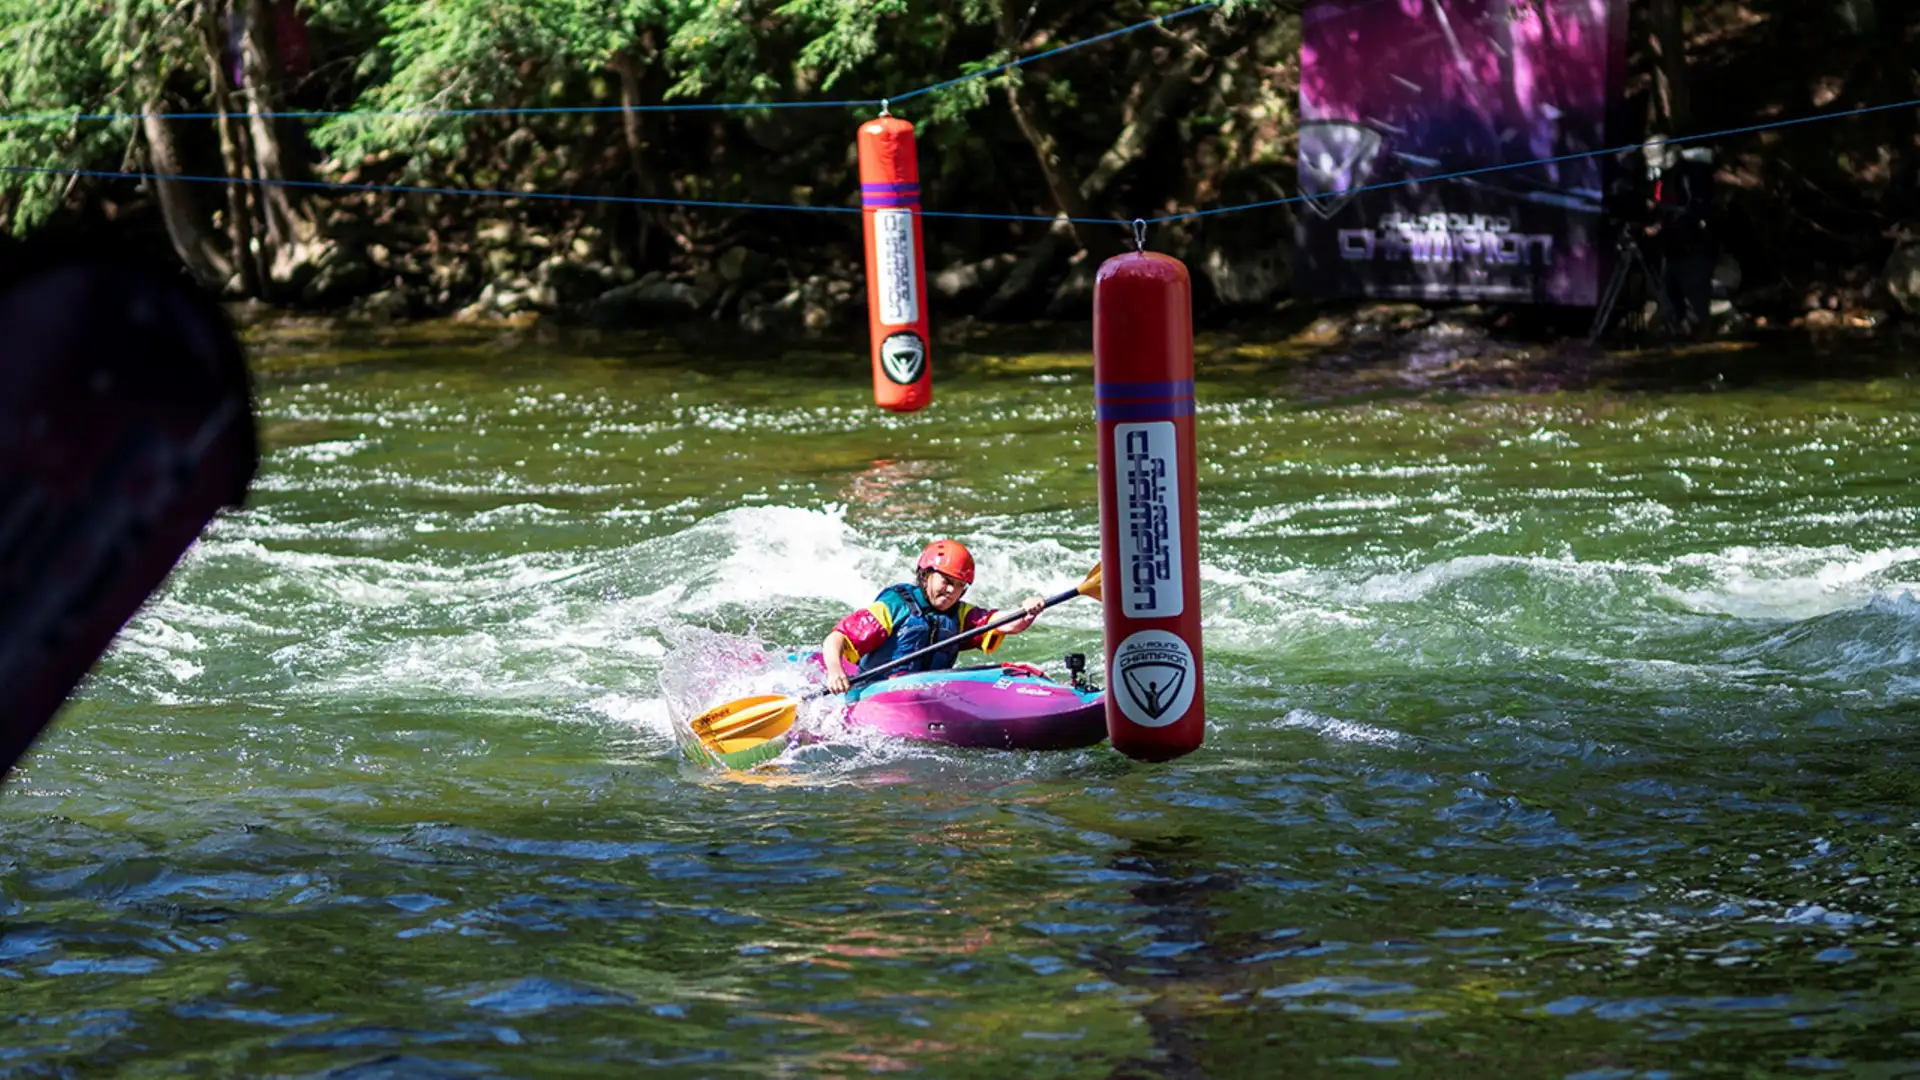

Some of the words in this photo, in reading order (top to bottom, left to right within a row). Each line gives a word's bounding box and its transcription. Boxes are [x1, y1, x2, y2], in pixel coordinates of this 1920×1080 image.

[1126, 430, 1156, 610] CHAMPION
[1151, 458, 1170, 580] ALL-ROUND
[1120, 652, 1187, 668] CHAMPION
